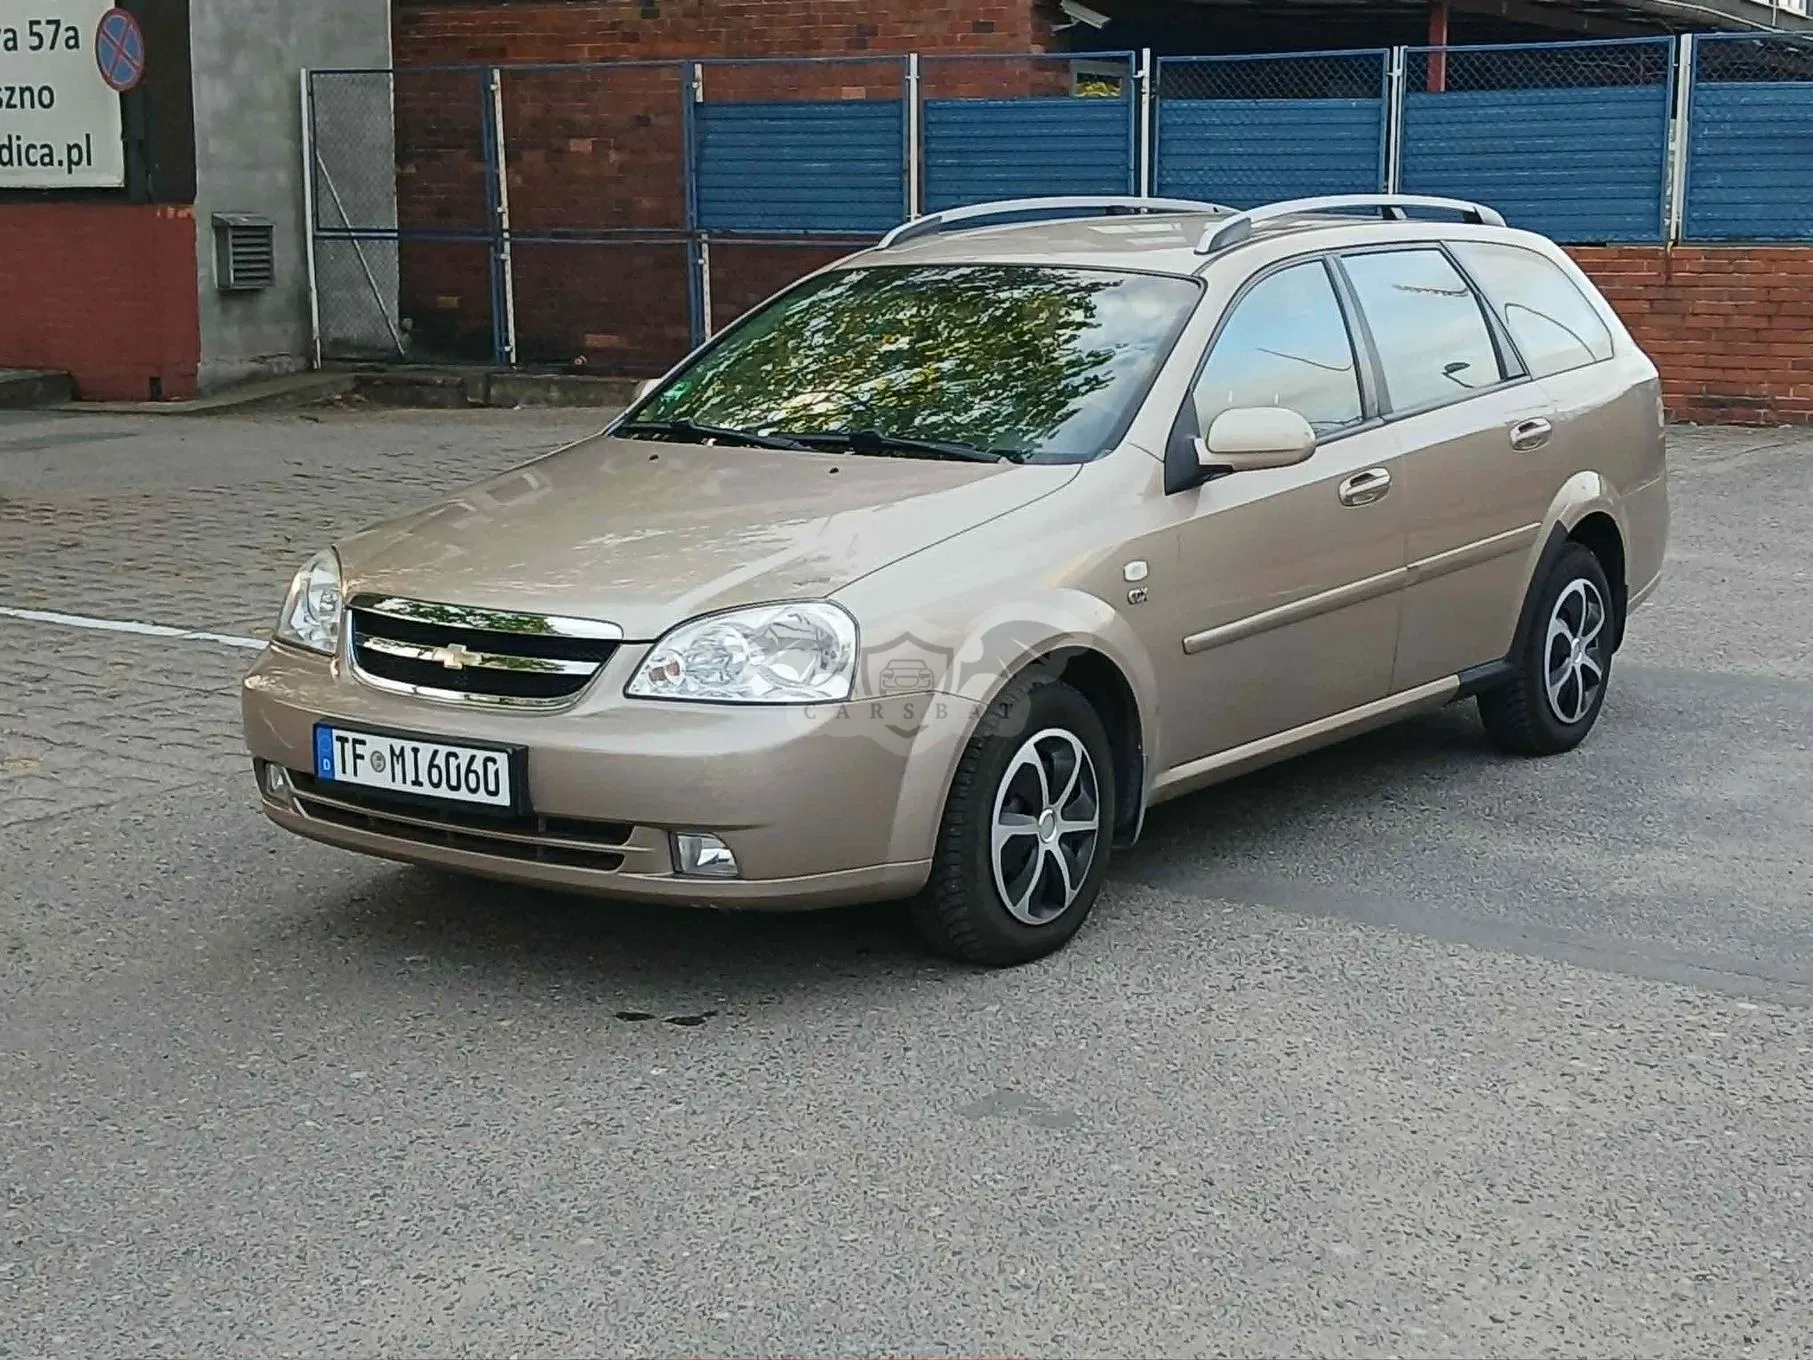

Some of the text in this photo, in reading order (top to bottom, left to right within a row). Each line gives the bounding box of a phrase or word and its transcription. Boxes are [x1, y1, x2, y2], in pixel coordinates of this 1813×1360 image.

[0, 19, 80, 51] a 57a
[0, 85, 55, 109] zno
[322, 735, 500, 797] D TF MI6060
